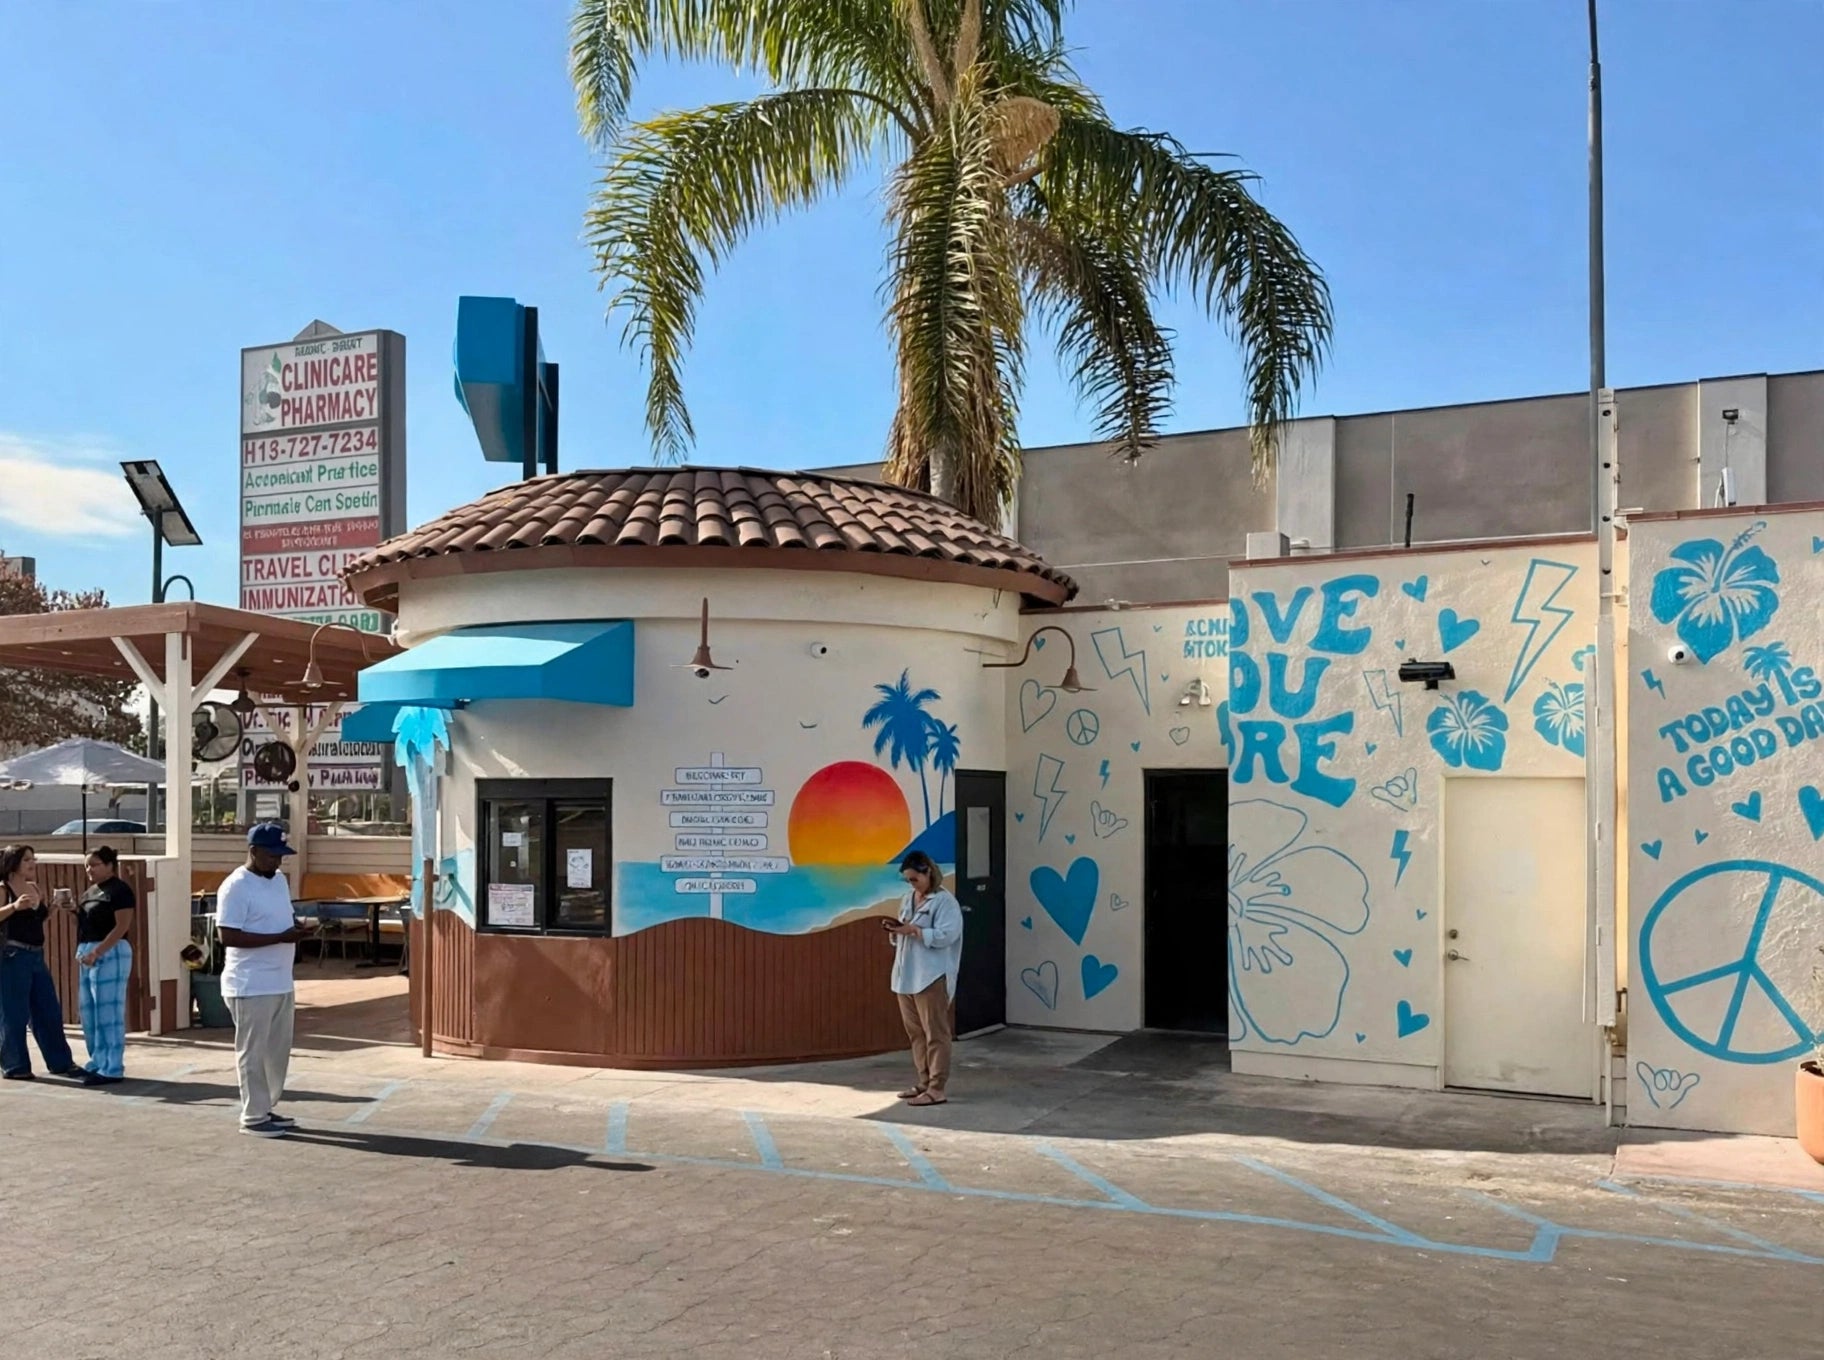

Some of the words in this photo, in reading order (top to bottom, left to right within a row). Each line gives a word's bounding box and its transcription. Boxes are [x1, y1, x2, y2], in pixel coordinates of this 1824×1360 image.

[282, 352, 378, 392] CLINICARE
[281, 387, 377, 426] PHARMACY
[243, 555, 312, 581] TRAVEL
[1659, 682, 1776, 753] TODAY
[1657, 767, 1688, 803] A
[1687, 728, 1777, 786] GOOD
[1776, 701, 1824, 747] DA
